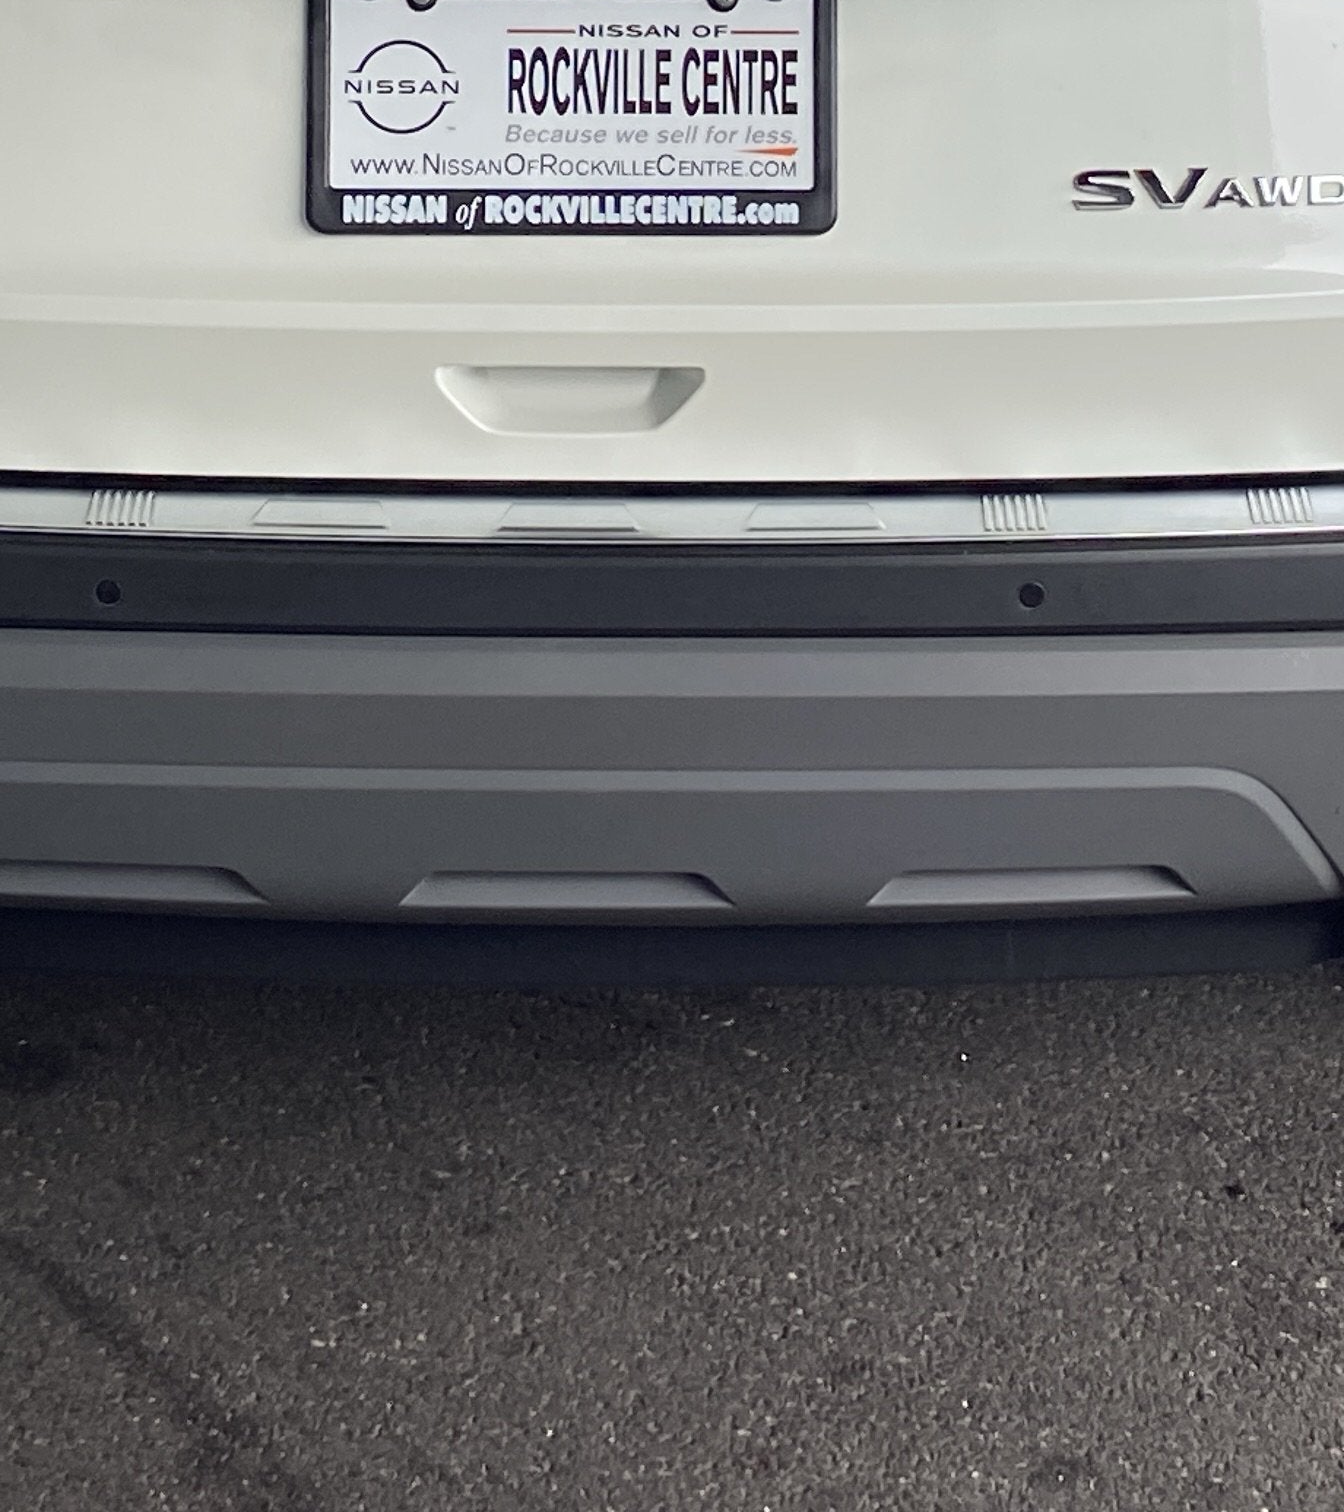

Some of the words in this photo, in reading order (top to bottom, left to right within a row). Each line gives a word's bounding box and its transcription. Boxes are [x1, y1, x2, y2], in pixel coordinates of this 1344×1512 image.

[578, 24, 681, 38] NISSAN
[692, 24, 729, 38] OF
[344, 80, 460, 94] NISSAN
[508, 46, 672, 116] ROCKVILLE
[681, 46, 799, 116] CENTRE
[505, 124, 607, 144] Because
[615, 129, 649, 144] we
[656, 125, 698, 144] sell
[706, 125, 739, 144] for
[744, 126, 798, 144] less.
[342, 194, 447, 224] NISSAN
[456, 196, 482, 230] of
[484, 194, 800, 226] ROCKVILLECENTRE.com
